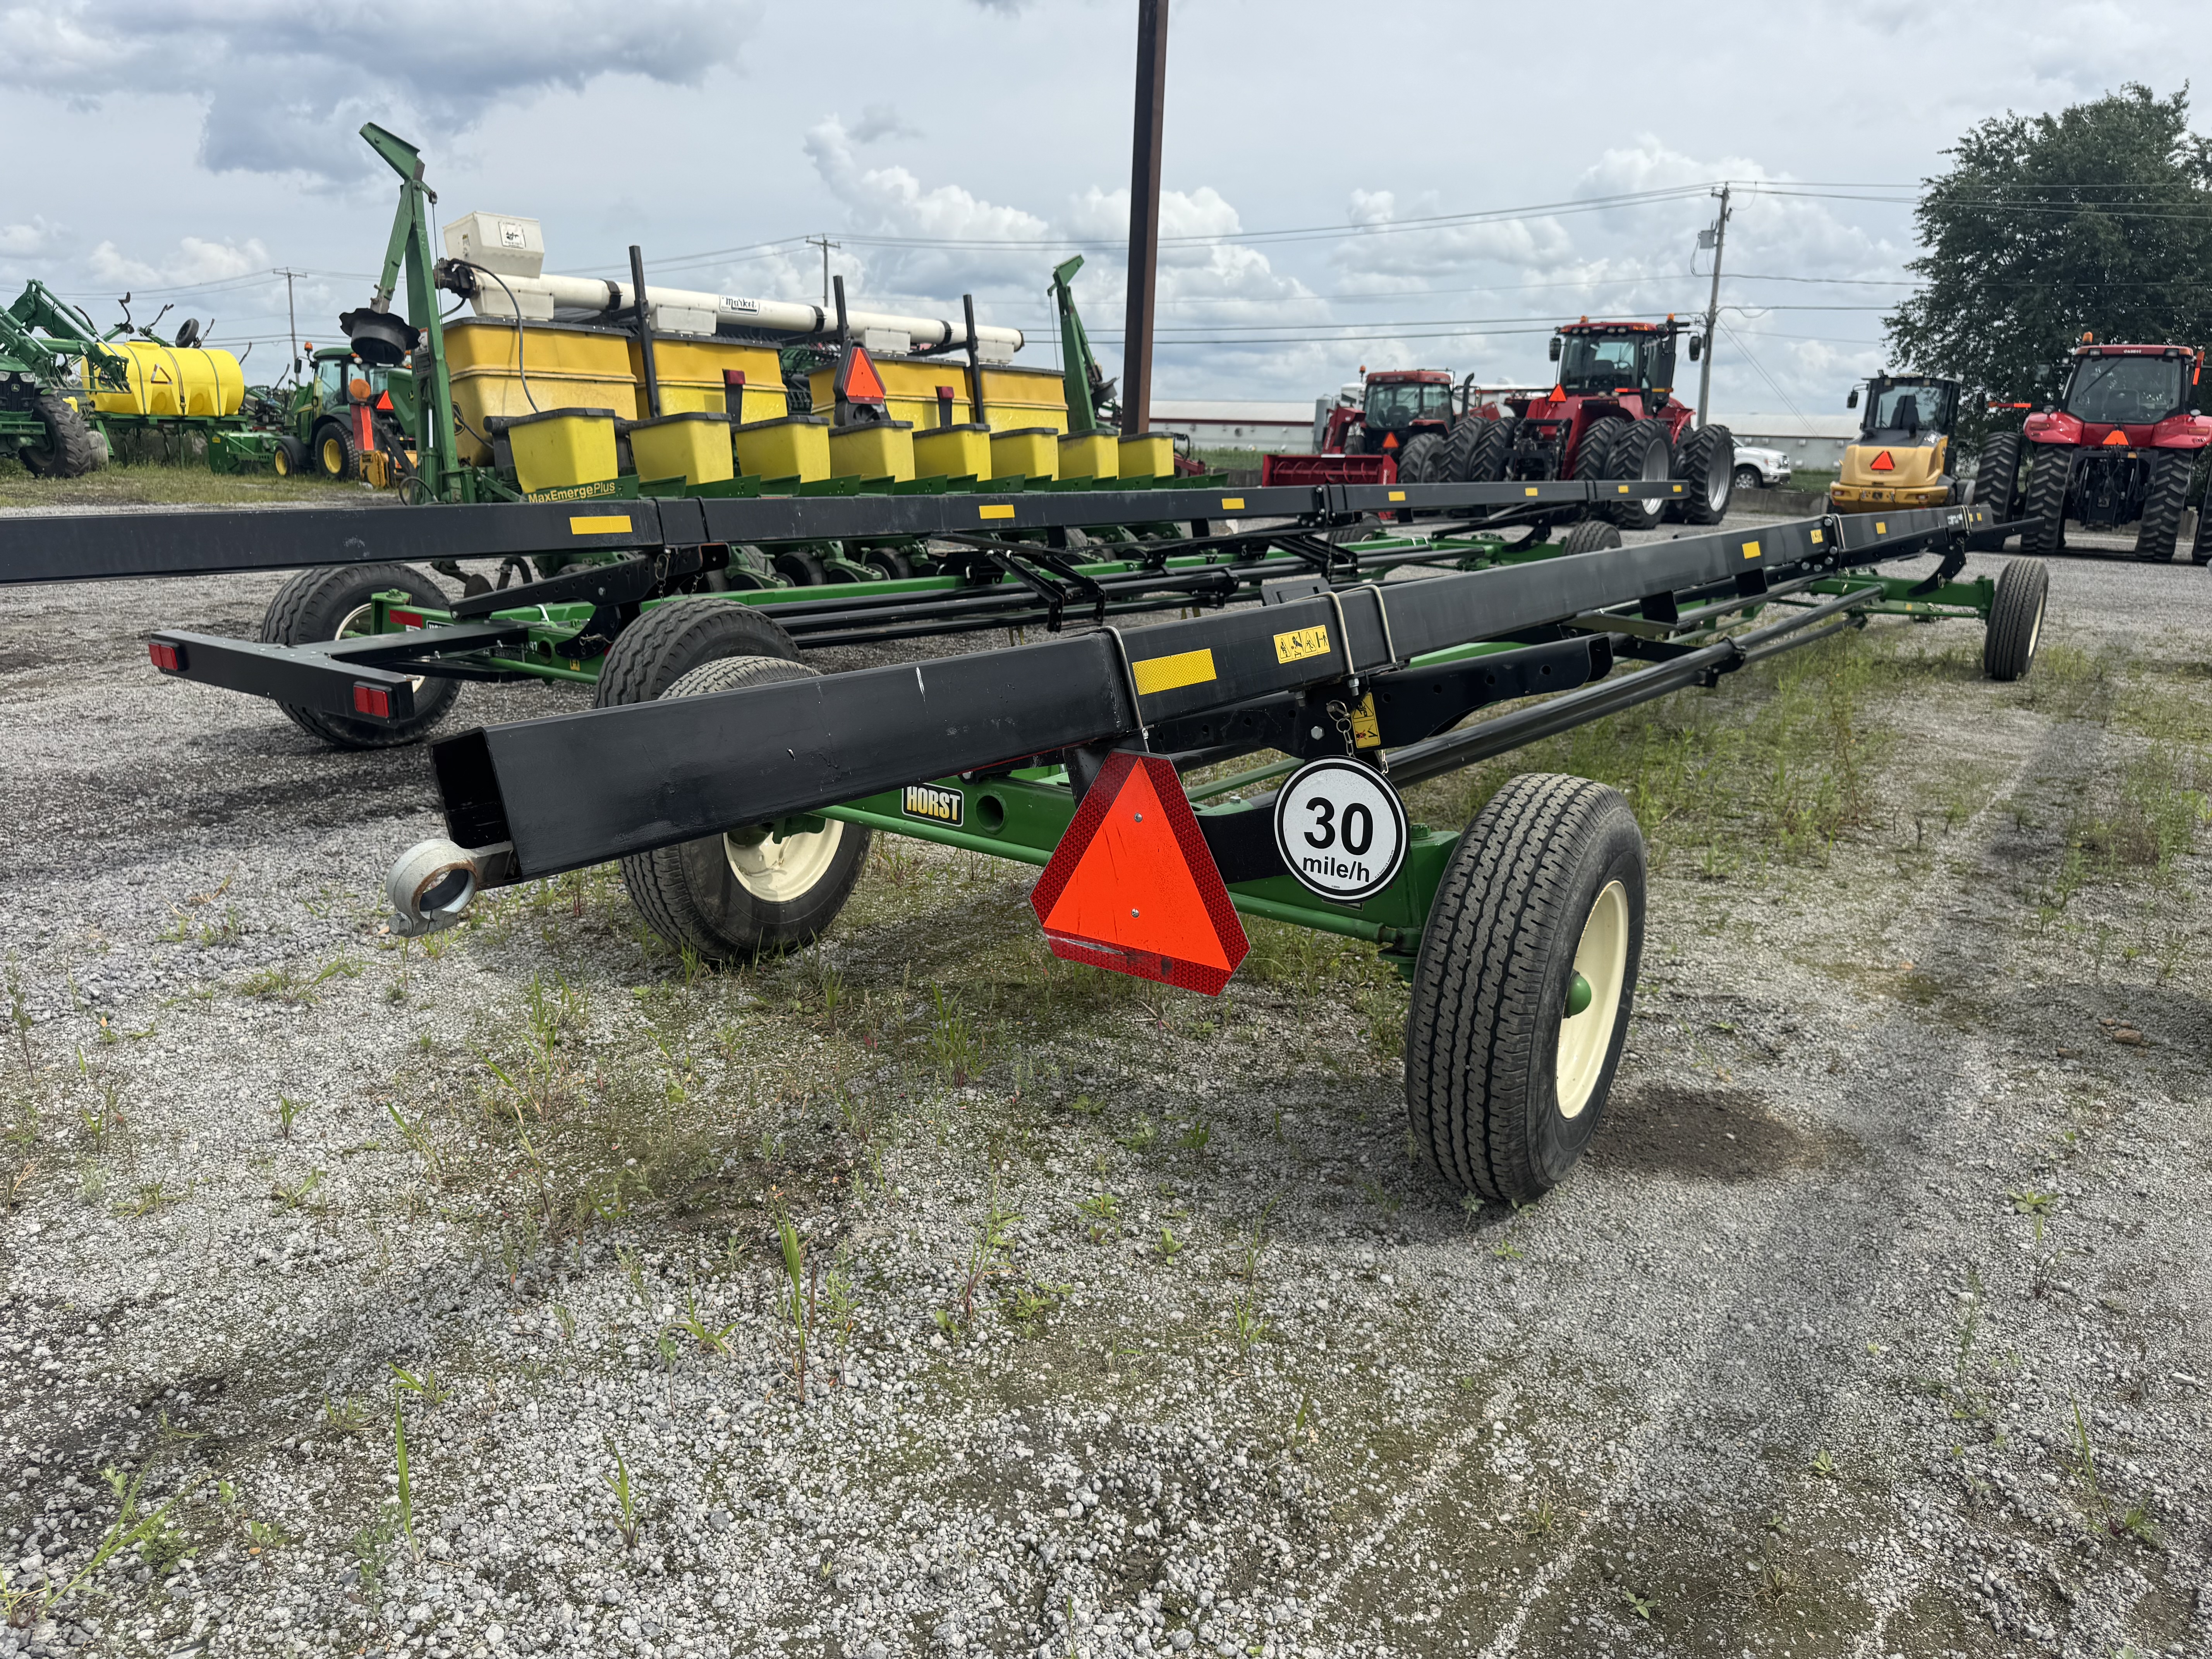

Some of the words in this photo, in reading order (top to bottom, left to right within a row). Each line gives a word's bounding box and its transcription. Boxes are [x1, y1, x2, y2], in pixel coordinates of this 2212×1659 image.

[907, 786, 960, 821] HORST
[1304, 797, 1374, 856] 30
[1302, 856, 1370, 883] mile/h
